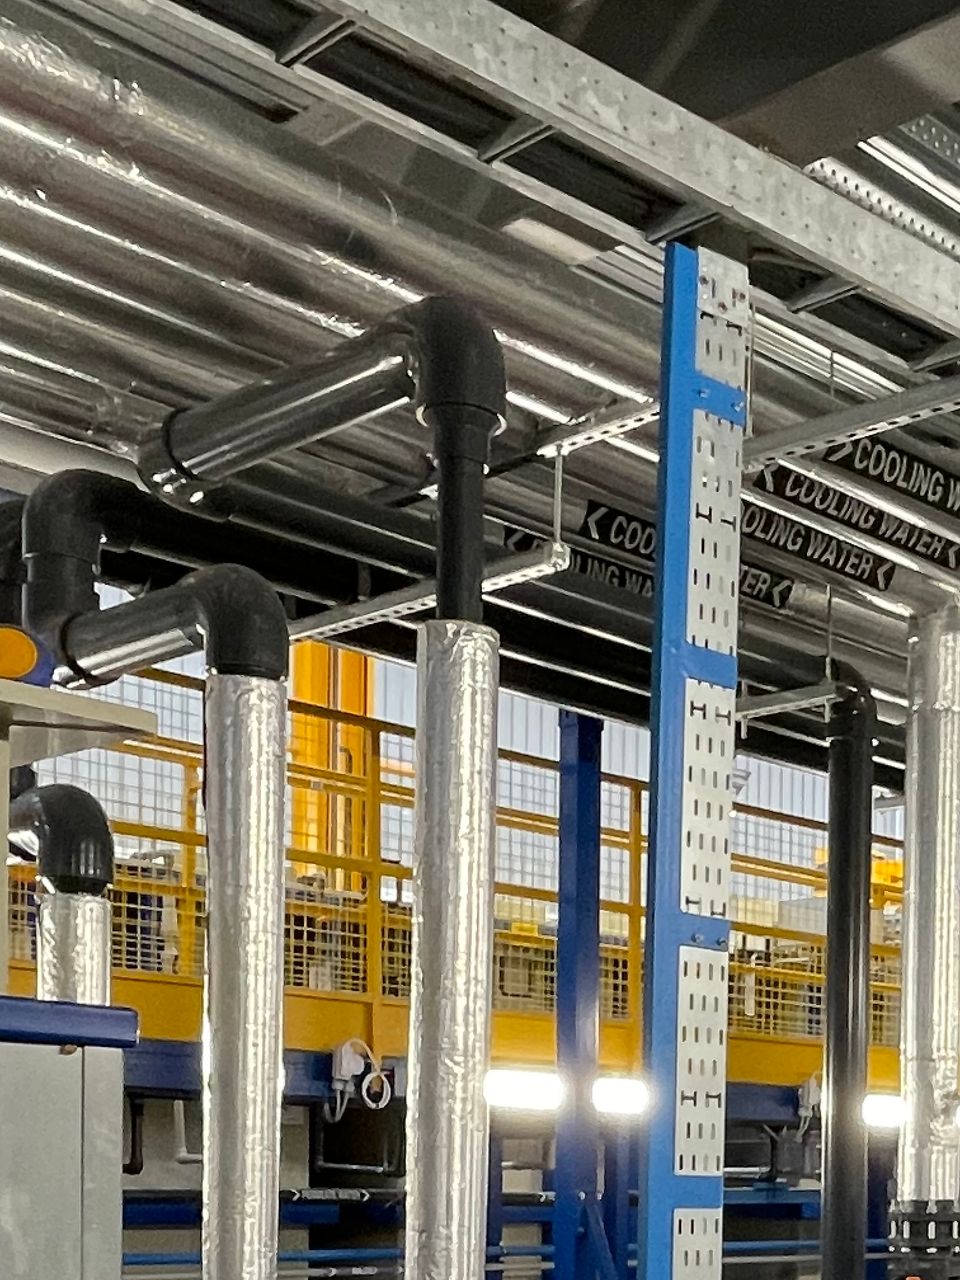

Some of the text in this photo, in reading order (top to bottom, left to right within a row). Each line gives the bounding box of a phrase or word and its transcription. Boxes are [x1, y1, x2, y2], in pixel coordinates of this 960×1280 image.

[854, 438, 945, 502] COOLING
[740, 501, 874, 580] OLING WATER
[785, 470, 946, 558] COOLING WATER
